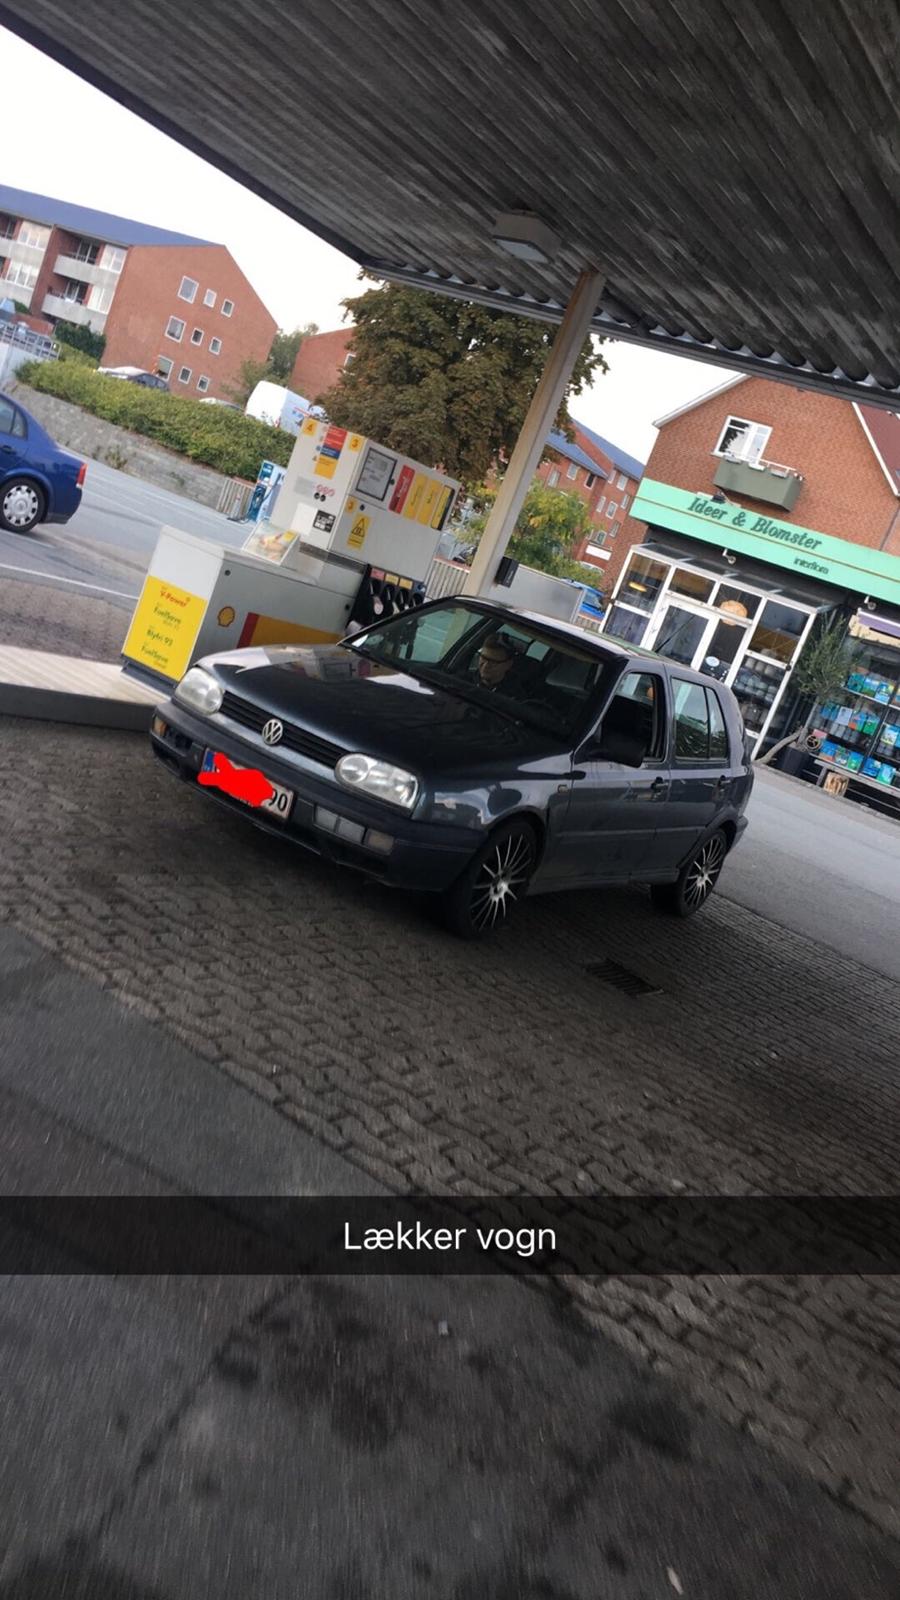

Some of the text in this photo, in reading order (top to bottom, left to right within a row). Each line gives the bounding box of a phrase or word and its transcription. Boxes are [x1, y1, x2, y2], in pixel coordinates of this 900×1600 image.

[688, 497, 823, 550] Ideer & Blomster
